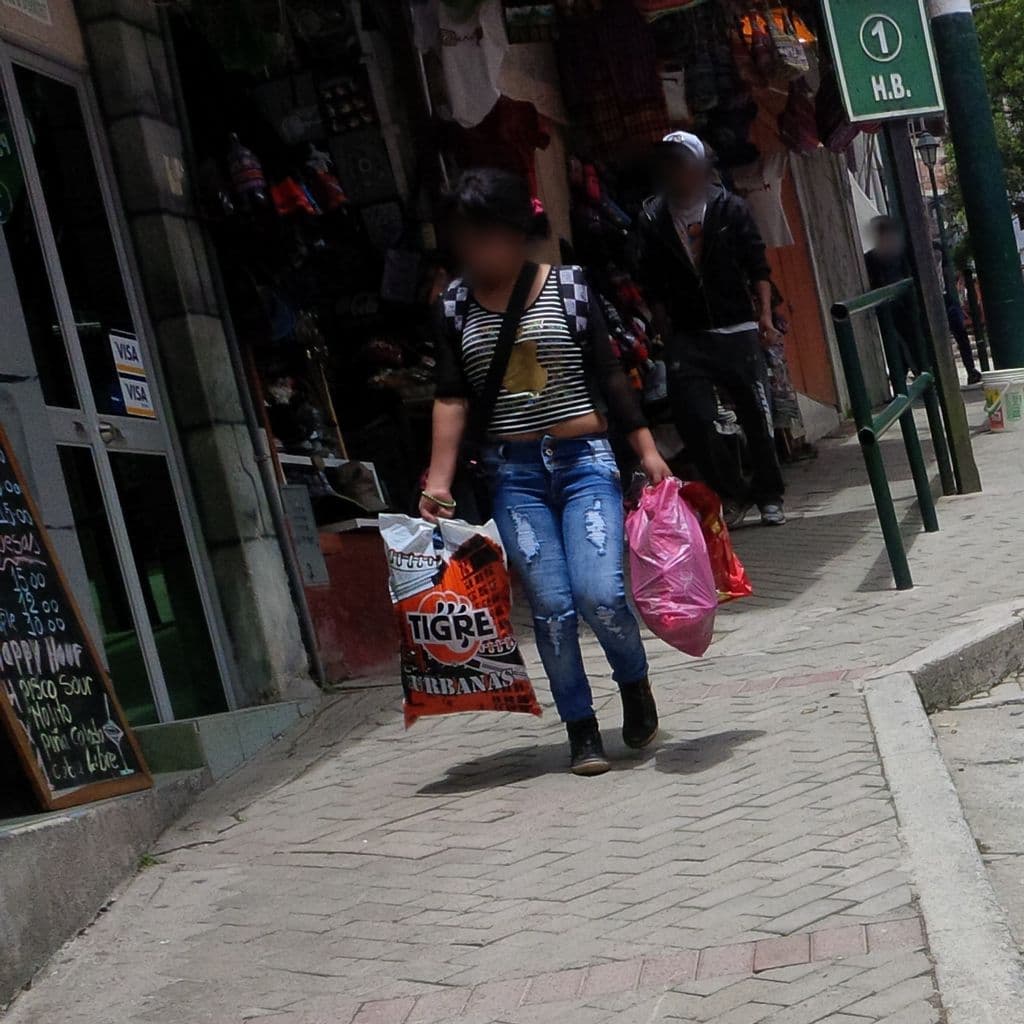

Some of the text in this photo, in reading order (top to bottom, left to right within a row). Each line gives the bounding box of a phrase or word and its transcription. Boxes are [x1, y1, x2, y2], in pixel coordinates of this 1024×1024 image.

[871, 20, 889, 54] 1
[871, 73, 912, 101] H.B.
[114, 341, 140, 362] VISA
[125, 383, 149, 403] VISA
[408, 612, 494, 642] TIGRE
[406, 667, 515, 696] URBANAS
